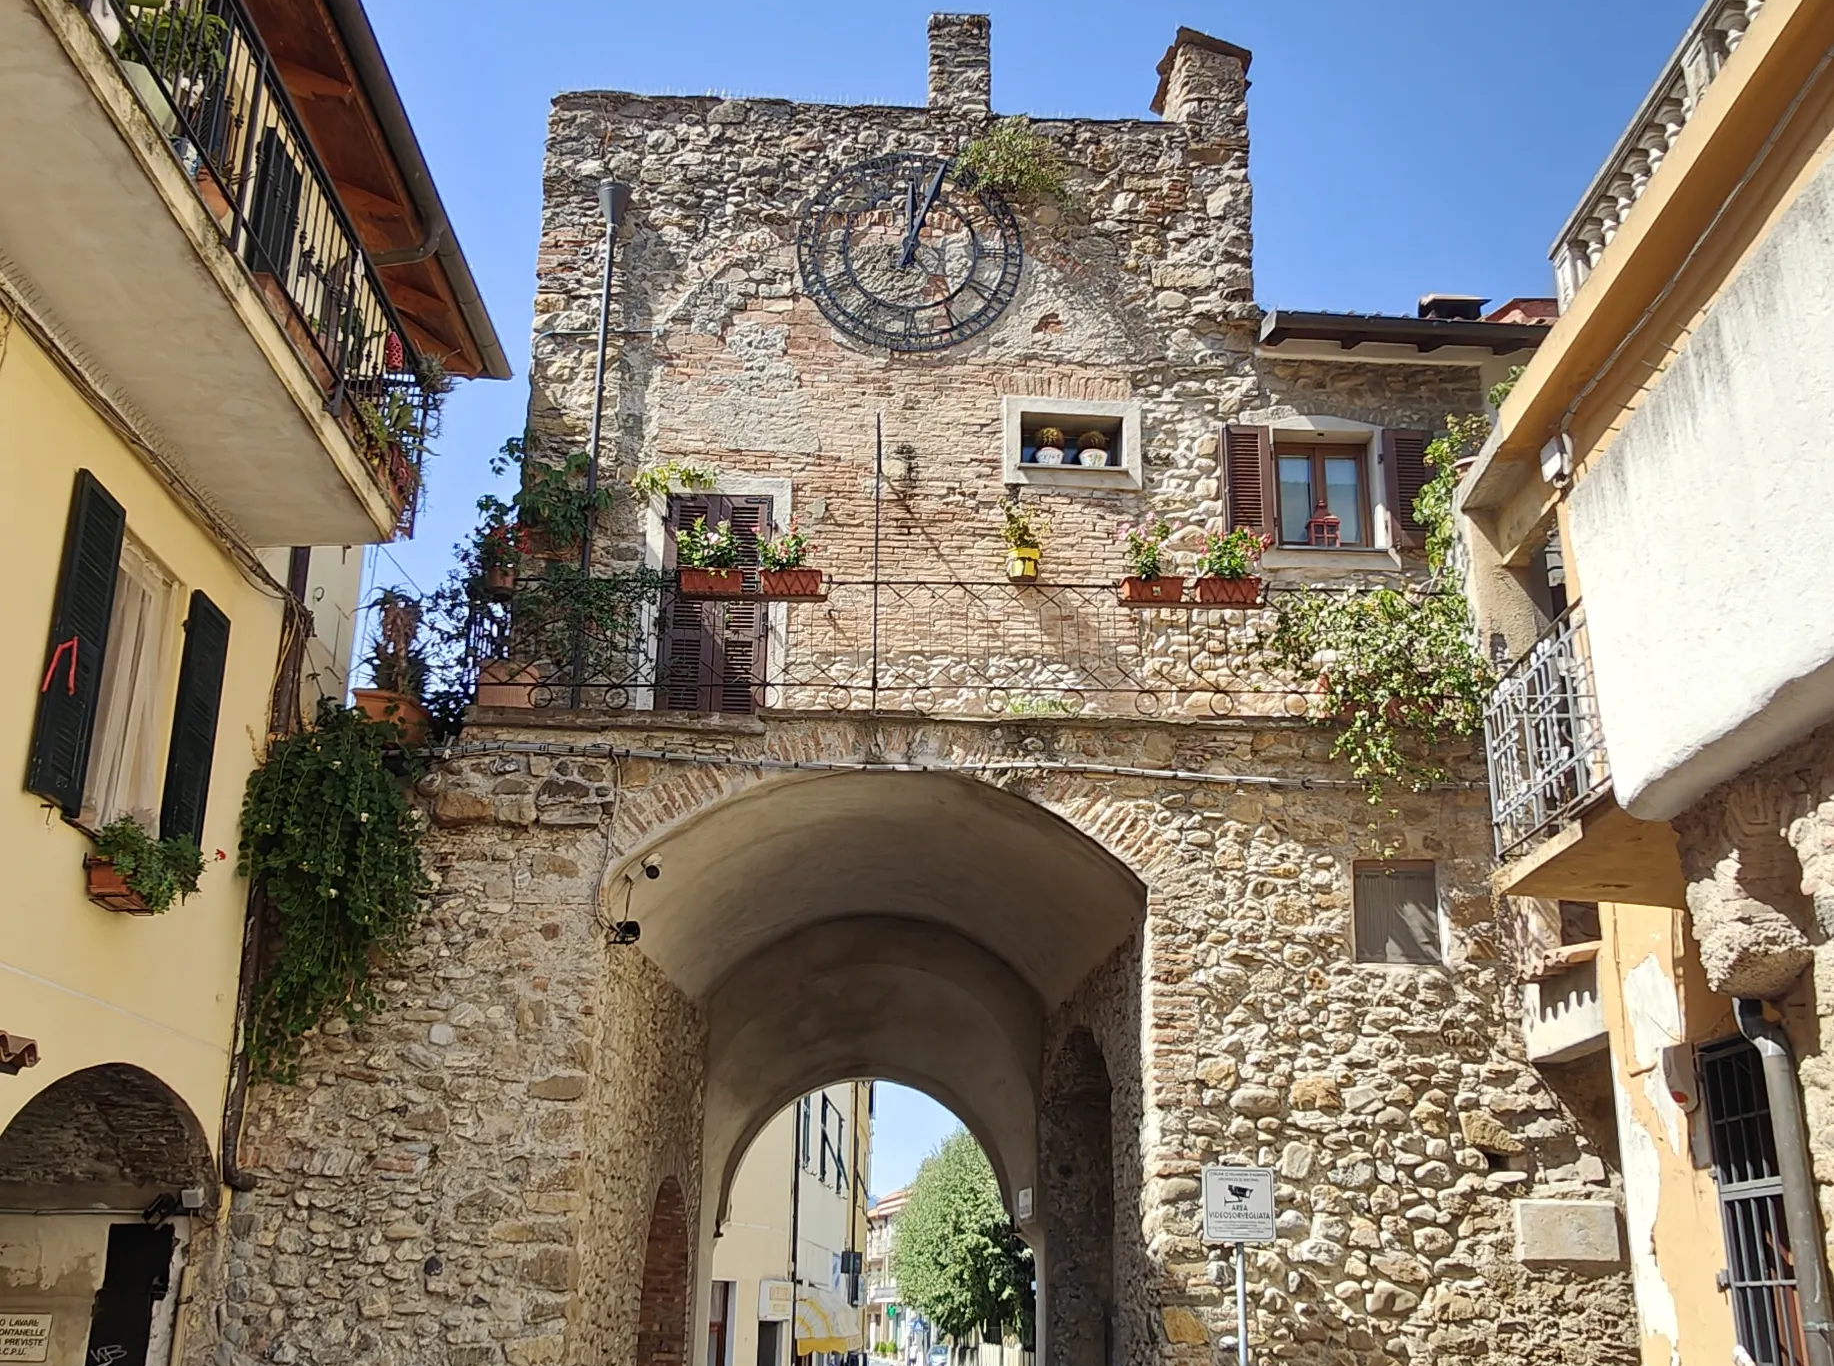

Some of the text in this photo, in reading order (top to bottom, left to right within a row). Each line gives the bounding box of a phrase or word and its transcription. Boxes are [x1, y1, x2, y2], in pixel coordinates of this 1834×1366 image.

[1231, 1204, 1249, 1212] AREA
[1208, 1211, 1271, 1220] VIDEOSORVEGLIATA
[9, 1318, 40, 1327] LAVARE
[4, 1337, 45, 1346] PREVISTE
